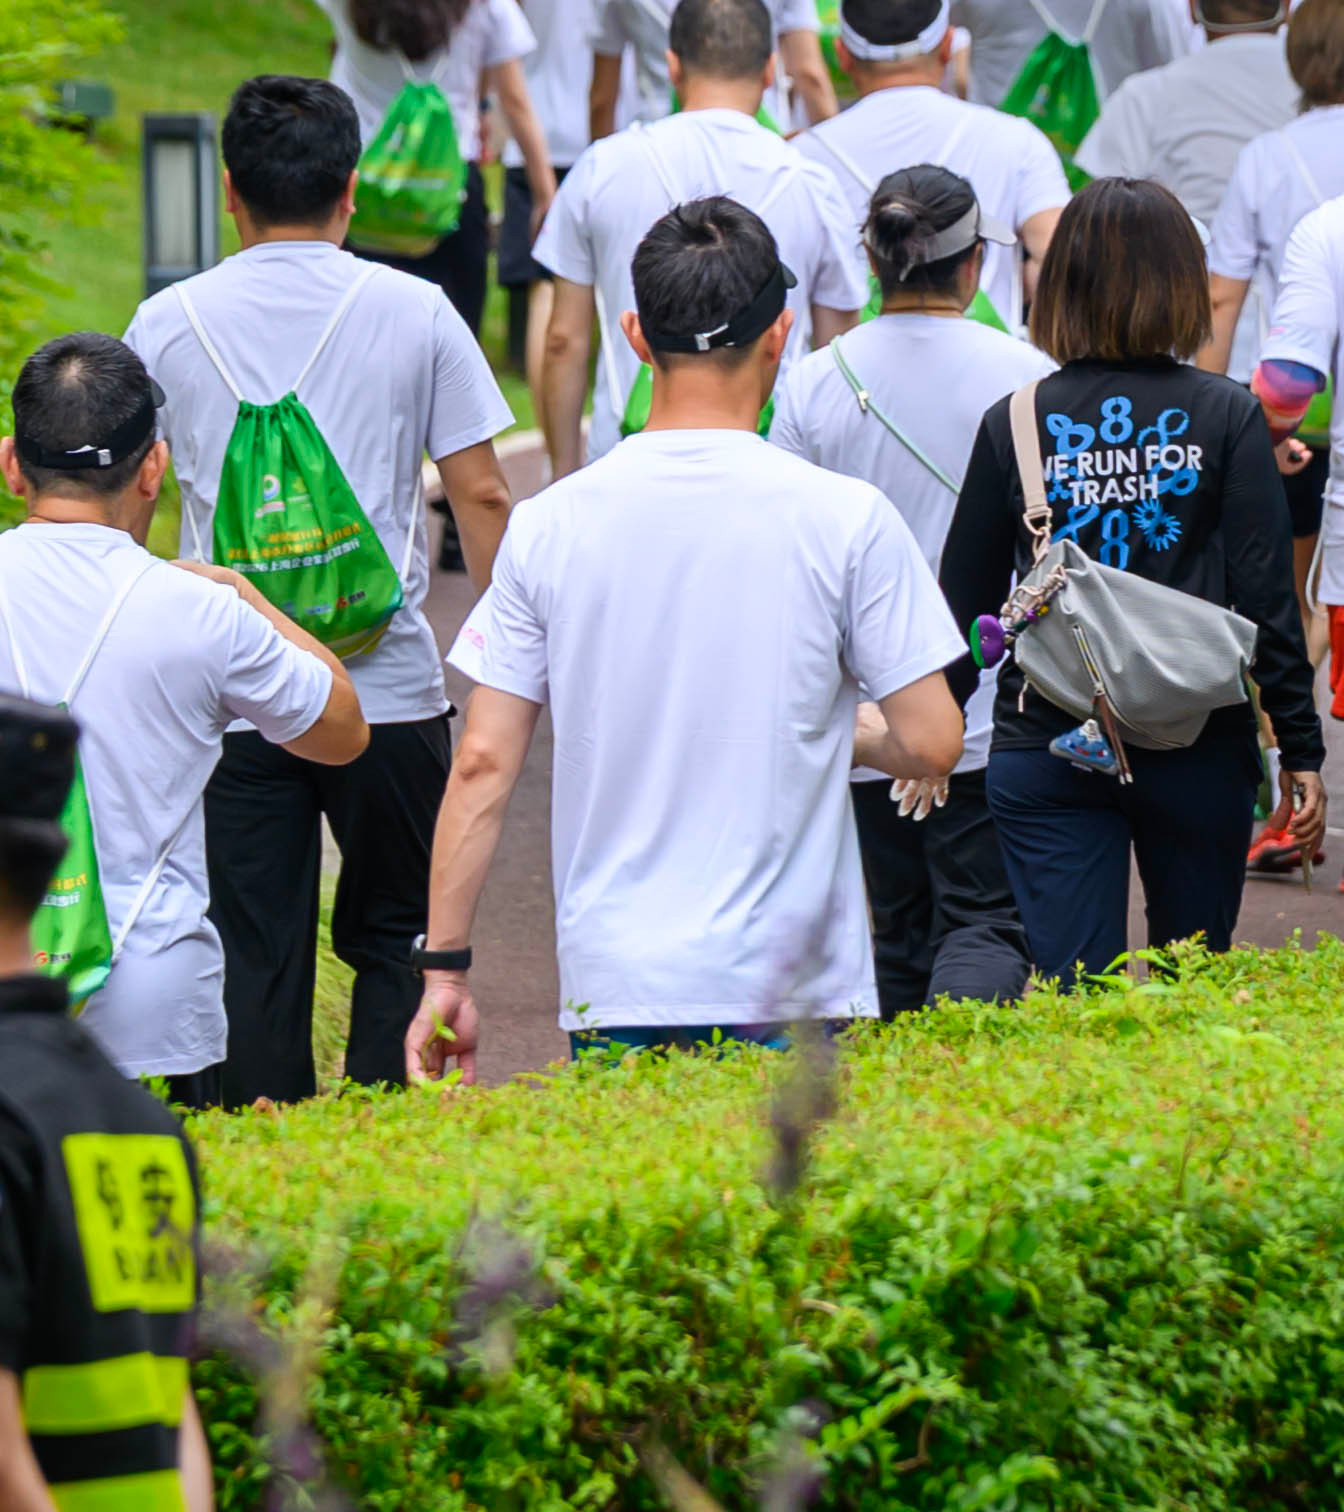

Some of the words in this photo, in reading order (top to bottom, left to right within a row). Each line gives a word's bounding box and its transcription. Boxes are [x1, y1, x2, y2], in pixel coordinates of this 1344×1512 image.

[1077, 448, 1137, 477] RUN
[1145, 444, 1204, 471] FOR
[1068, 474, 1159, 507] TRASH
